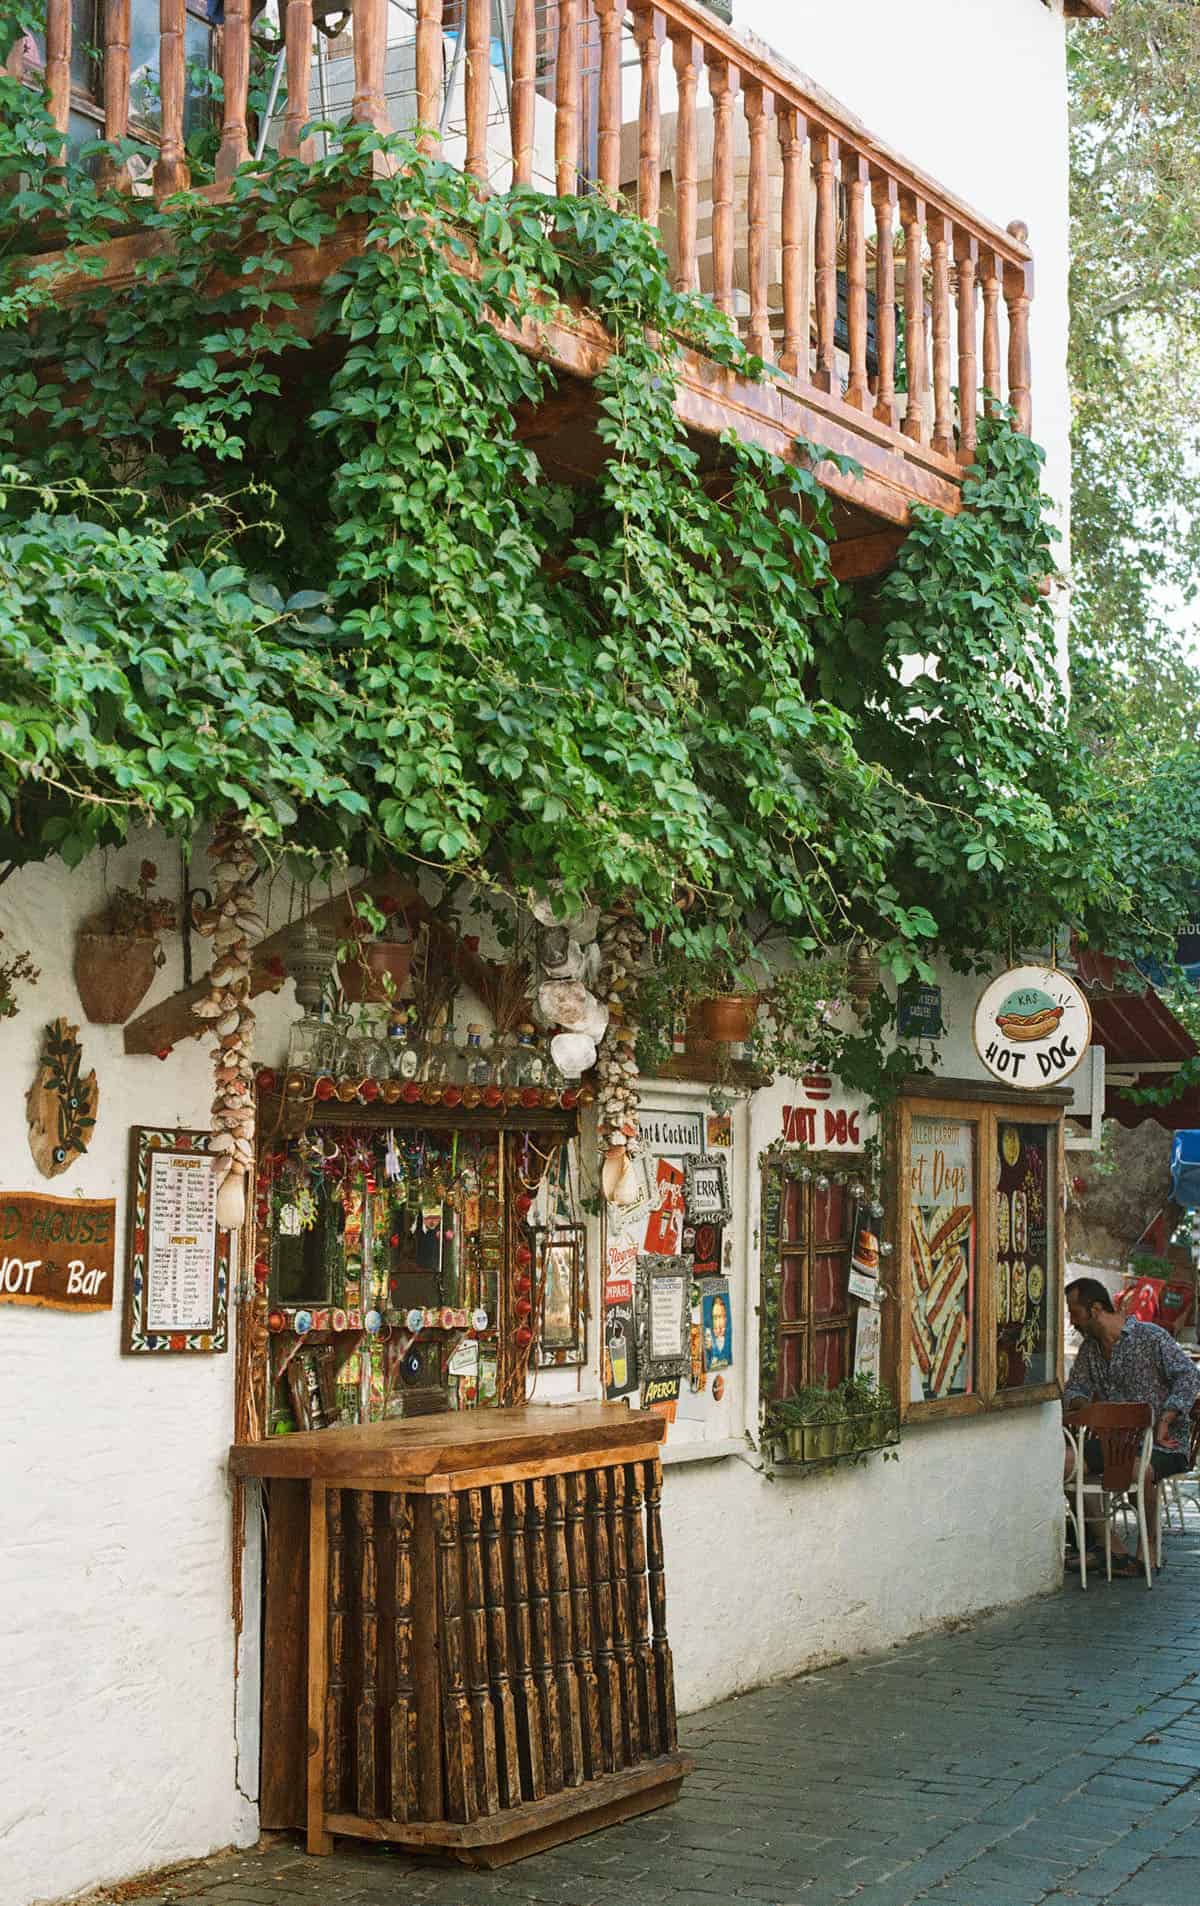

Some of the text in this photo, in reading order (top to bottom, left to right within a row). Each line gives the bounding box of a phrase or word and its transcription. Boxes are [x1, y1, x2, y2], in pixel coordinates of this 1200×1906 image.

[985, 1035, 1077, 1078] HOT DOG
[655, 1122, 661, 1143] &
[662, 1123, 699, 1145] Cocktail
[824, 1109, 860, 1145] DOG
[932, 1150, 966, 1208] Dogs
[31, 1209, 112, 1244] HOUSE
[66, 1260, 107, 1296] Bar
[645, 1380, 678, 1402] APEROL
